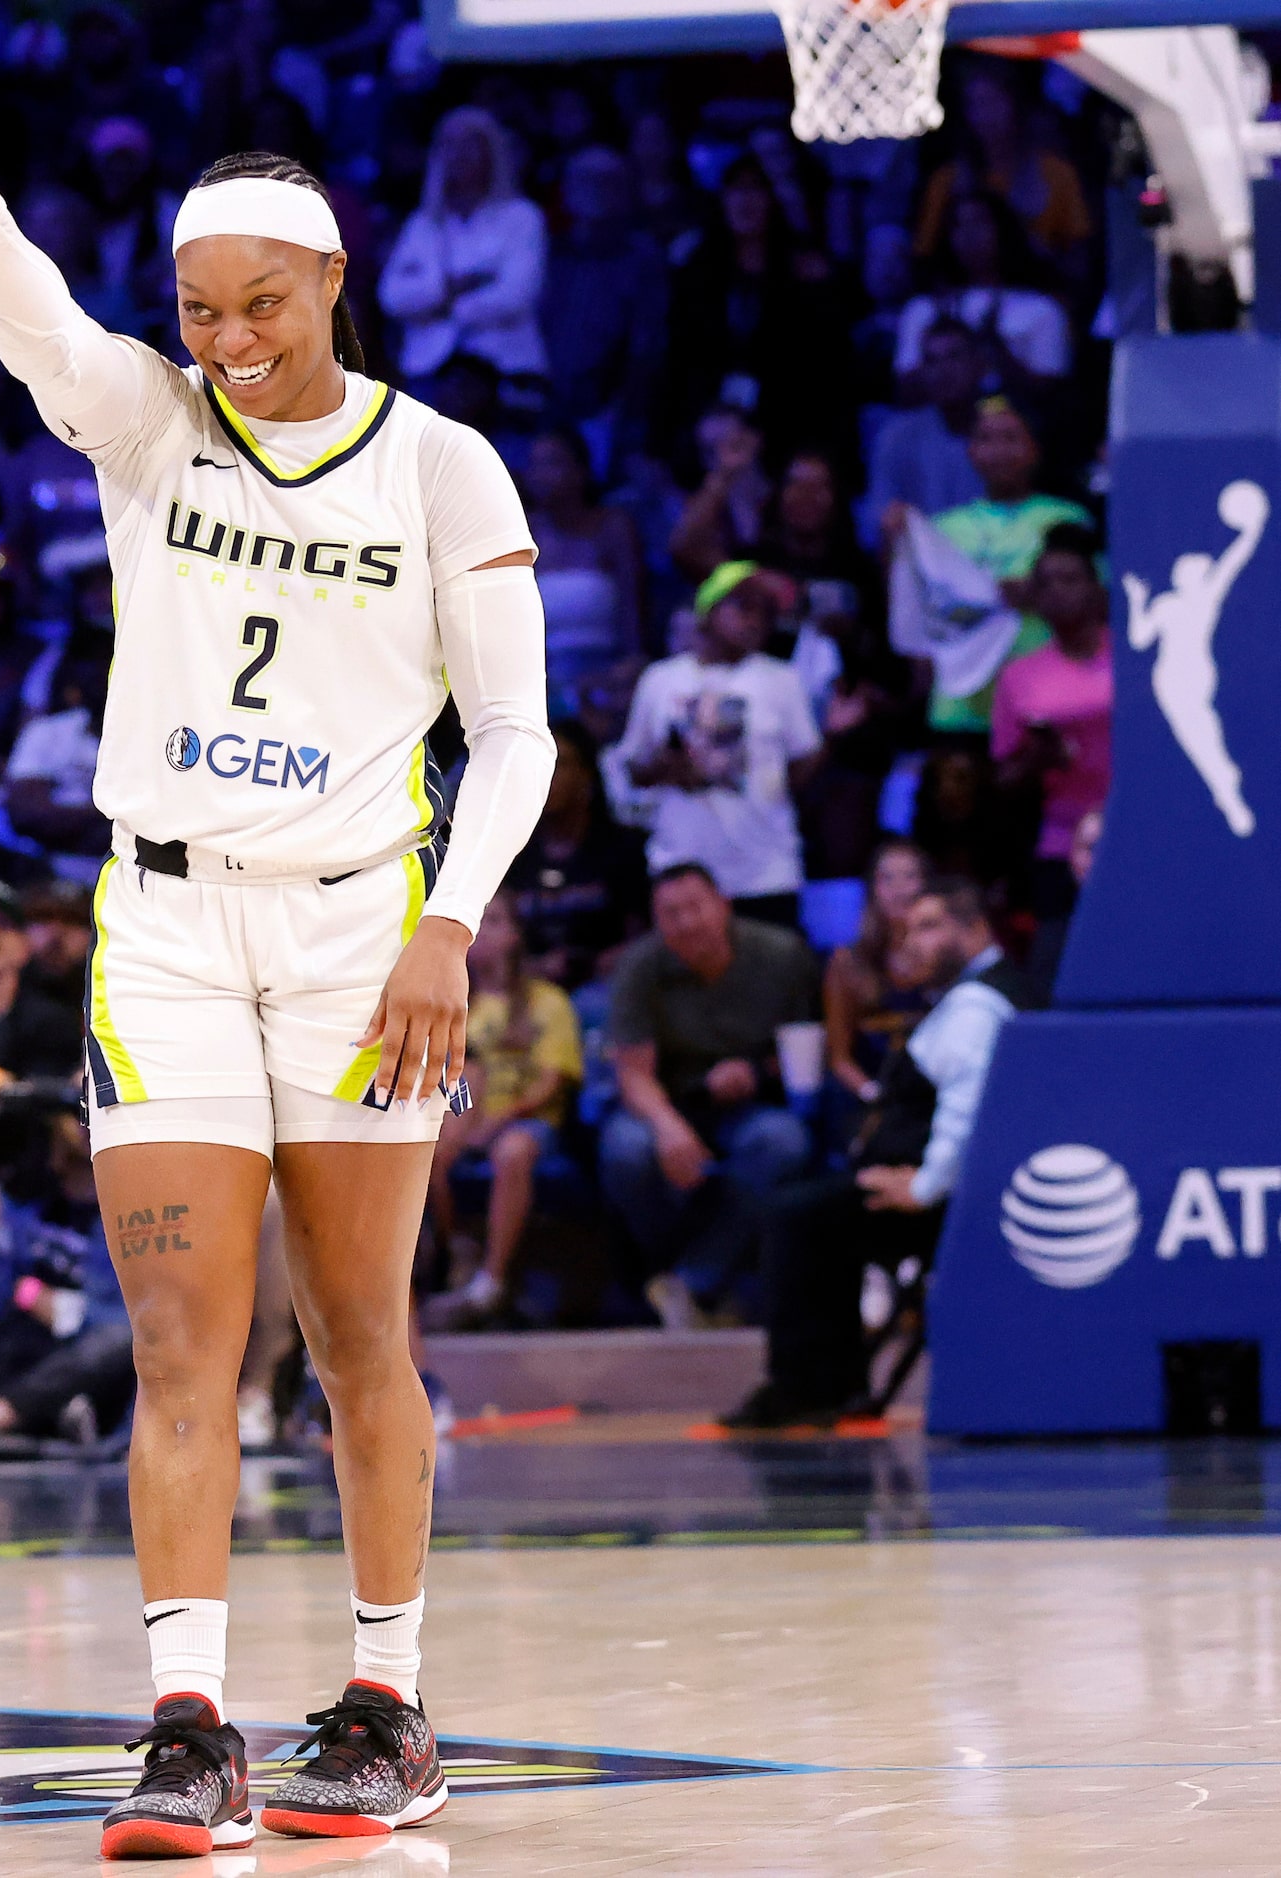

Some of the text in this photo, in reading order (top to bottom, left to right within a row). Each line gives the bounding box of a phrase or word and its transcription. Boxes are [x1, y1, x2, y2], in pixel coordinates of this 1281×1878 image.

[165, 498, 403, 590] WINGS
[176, 562, 368, 609] DALLAS
[230, 614, 280, 712] 2
[206, 733, 331, 795] GEM
[1154, 1165, 1281, 1260] AT
